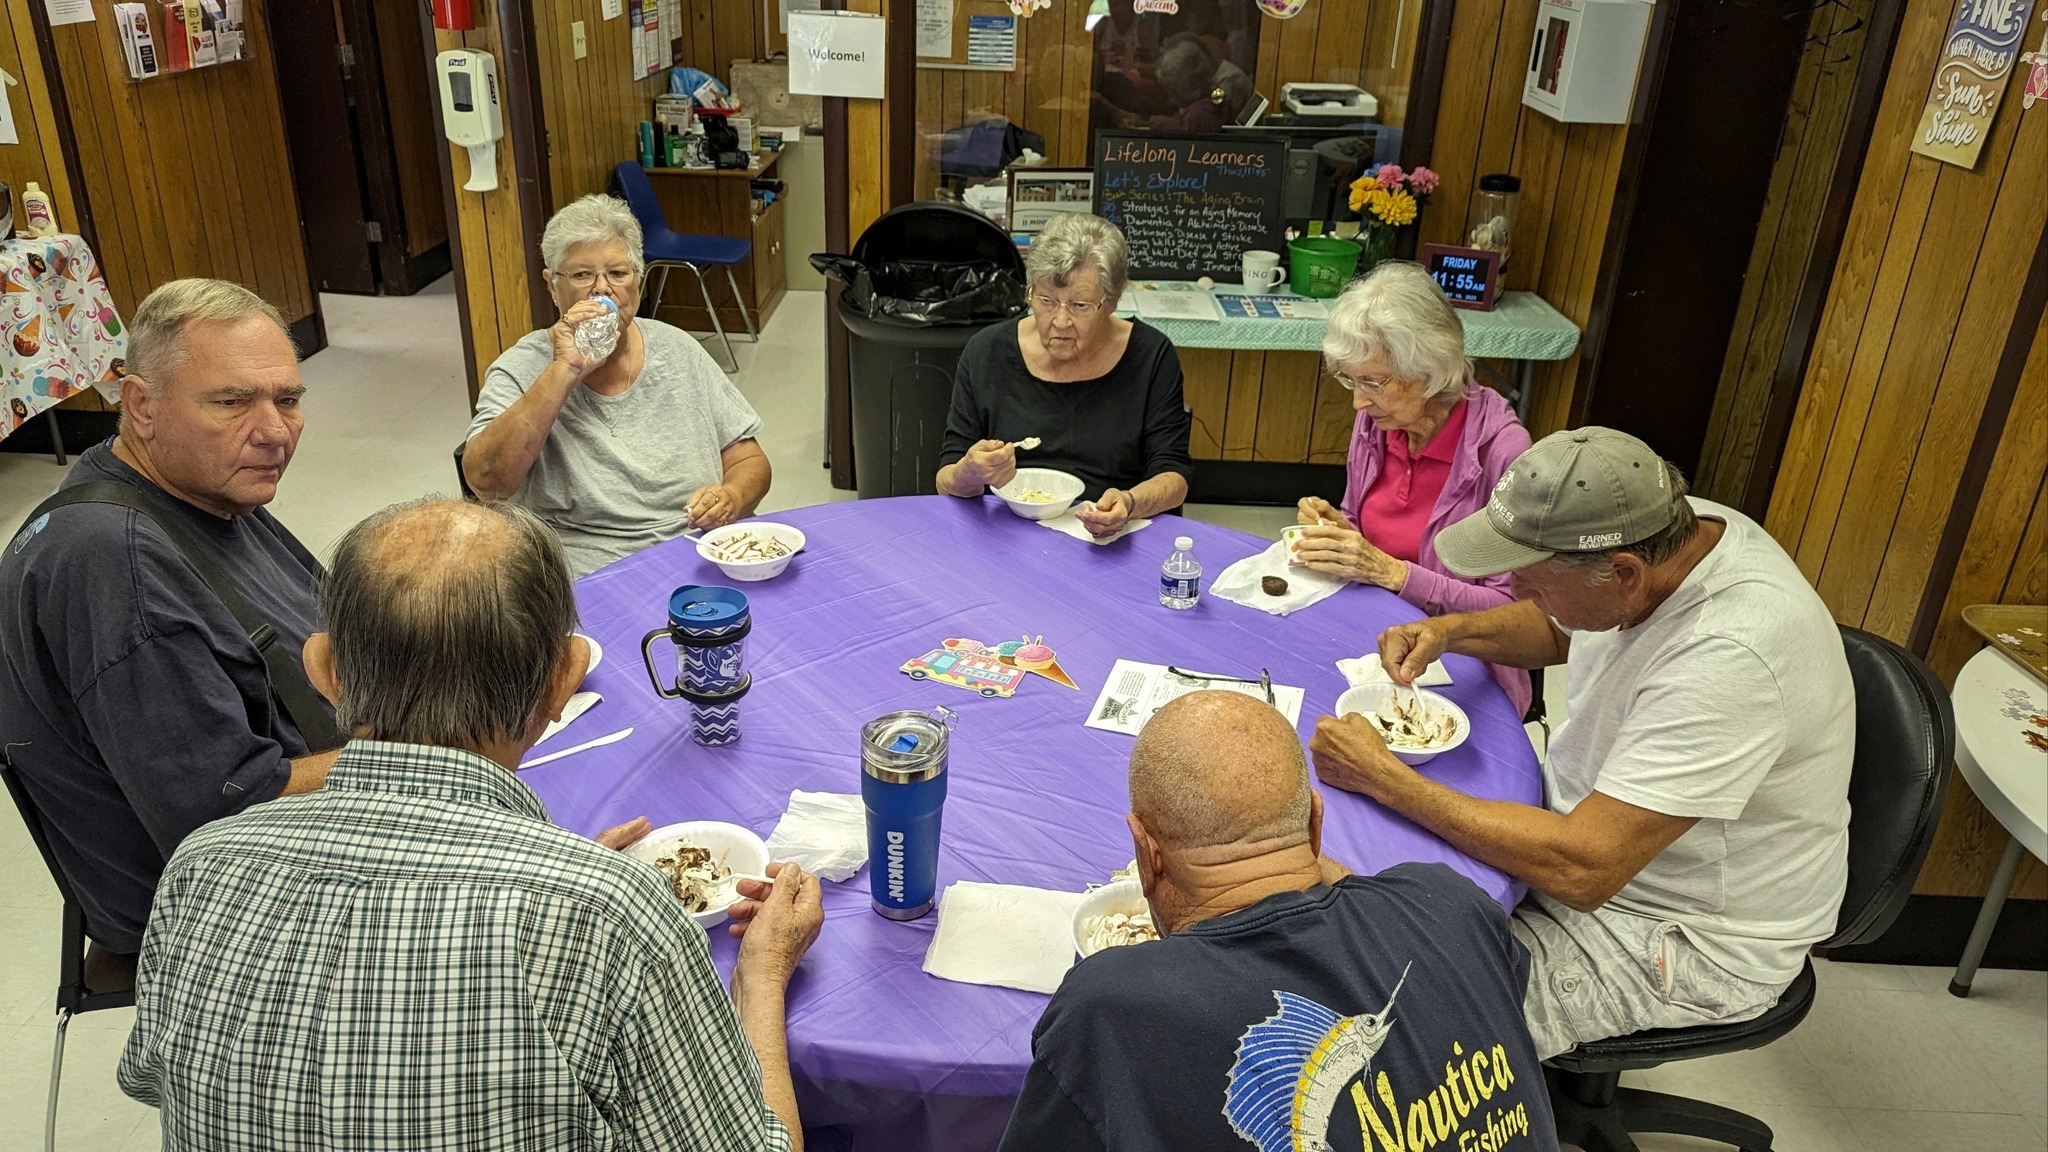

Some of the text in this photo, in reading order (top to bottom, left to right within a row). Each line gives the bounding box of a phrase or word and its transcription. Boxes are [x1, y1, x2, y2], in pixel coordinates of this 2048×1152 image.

[1970, 0, 2014, 33] FINE
[808, 48, 865, 62] Welcome!
[1950, 38, 2008, 72] WHEN THERE IS
[1943, 71, 1984, 115] Sun
[1925, 110, 1978, 147] Shine
[1104, 141, 1265, 182] Lifelong Learners
[1104, 170, 1209, 193] Let's Explore!
[1173, 191, 1196, 205] The
[1202, 191, 1231, 208] Aging
[1231, 191, 1265, 206] Brain
[1122, 200, 1169, 218] Strategies
[1172, 204, 1187, 216] for
[1189, 208, 1200, 216] an
[1202, 206, 1225, 224] Aging
[1226, 207, 1262, 226] Memory
[1124, 214, 1174, 227] Dementia
[1237, 220, 1268, 234] Disease
[1125, 225, 1174, 239] Parkinson's
[1174, 228, 1207, 240] Disease
[1221, 231, 1253, 244] Stroke
[1126, 236, 1150, 250] Aging
[1176, 239, 1212, 254] Staying
[1216, 240, 1241, 252] Active
[1174, 247, 1198, 259] Diet
[1202, 251, 1217, 259] and
[1127, 258, 1141, 268] The
[1147, 256, 1179, 269] Science
[1186, 259, 1197, 270] of
[1443, 256, 1478, 270] FRIDAY
[1578, 539, 1622, 550] NEVER GIVEN
[1579, 532, 1622, 544] EARNED
[886, 830, 905, 903] DUNKIN'
[1350, 1040, 1515, 1152] Nautica
[1458, 1101, 1529, 1152] Fishing
